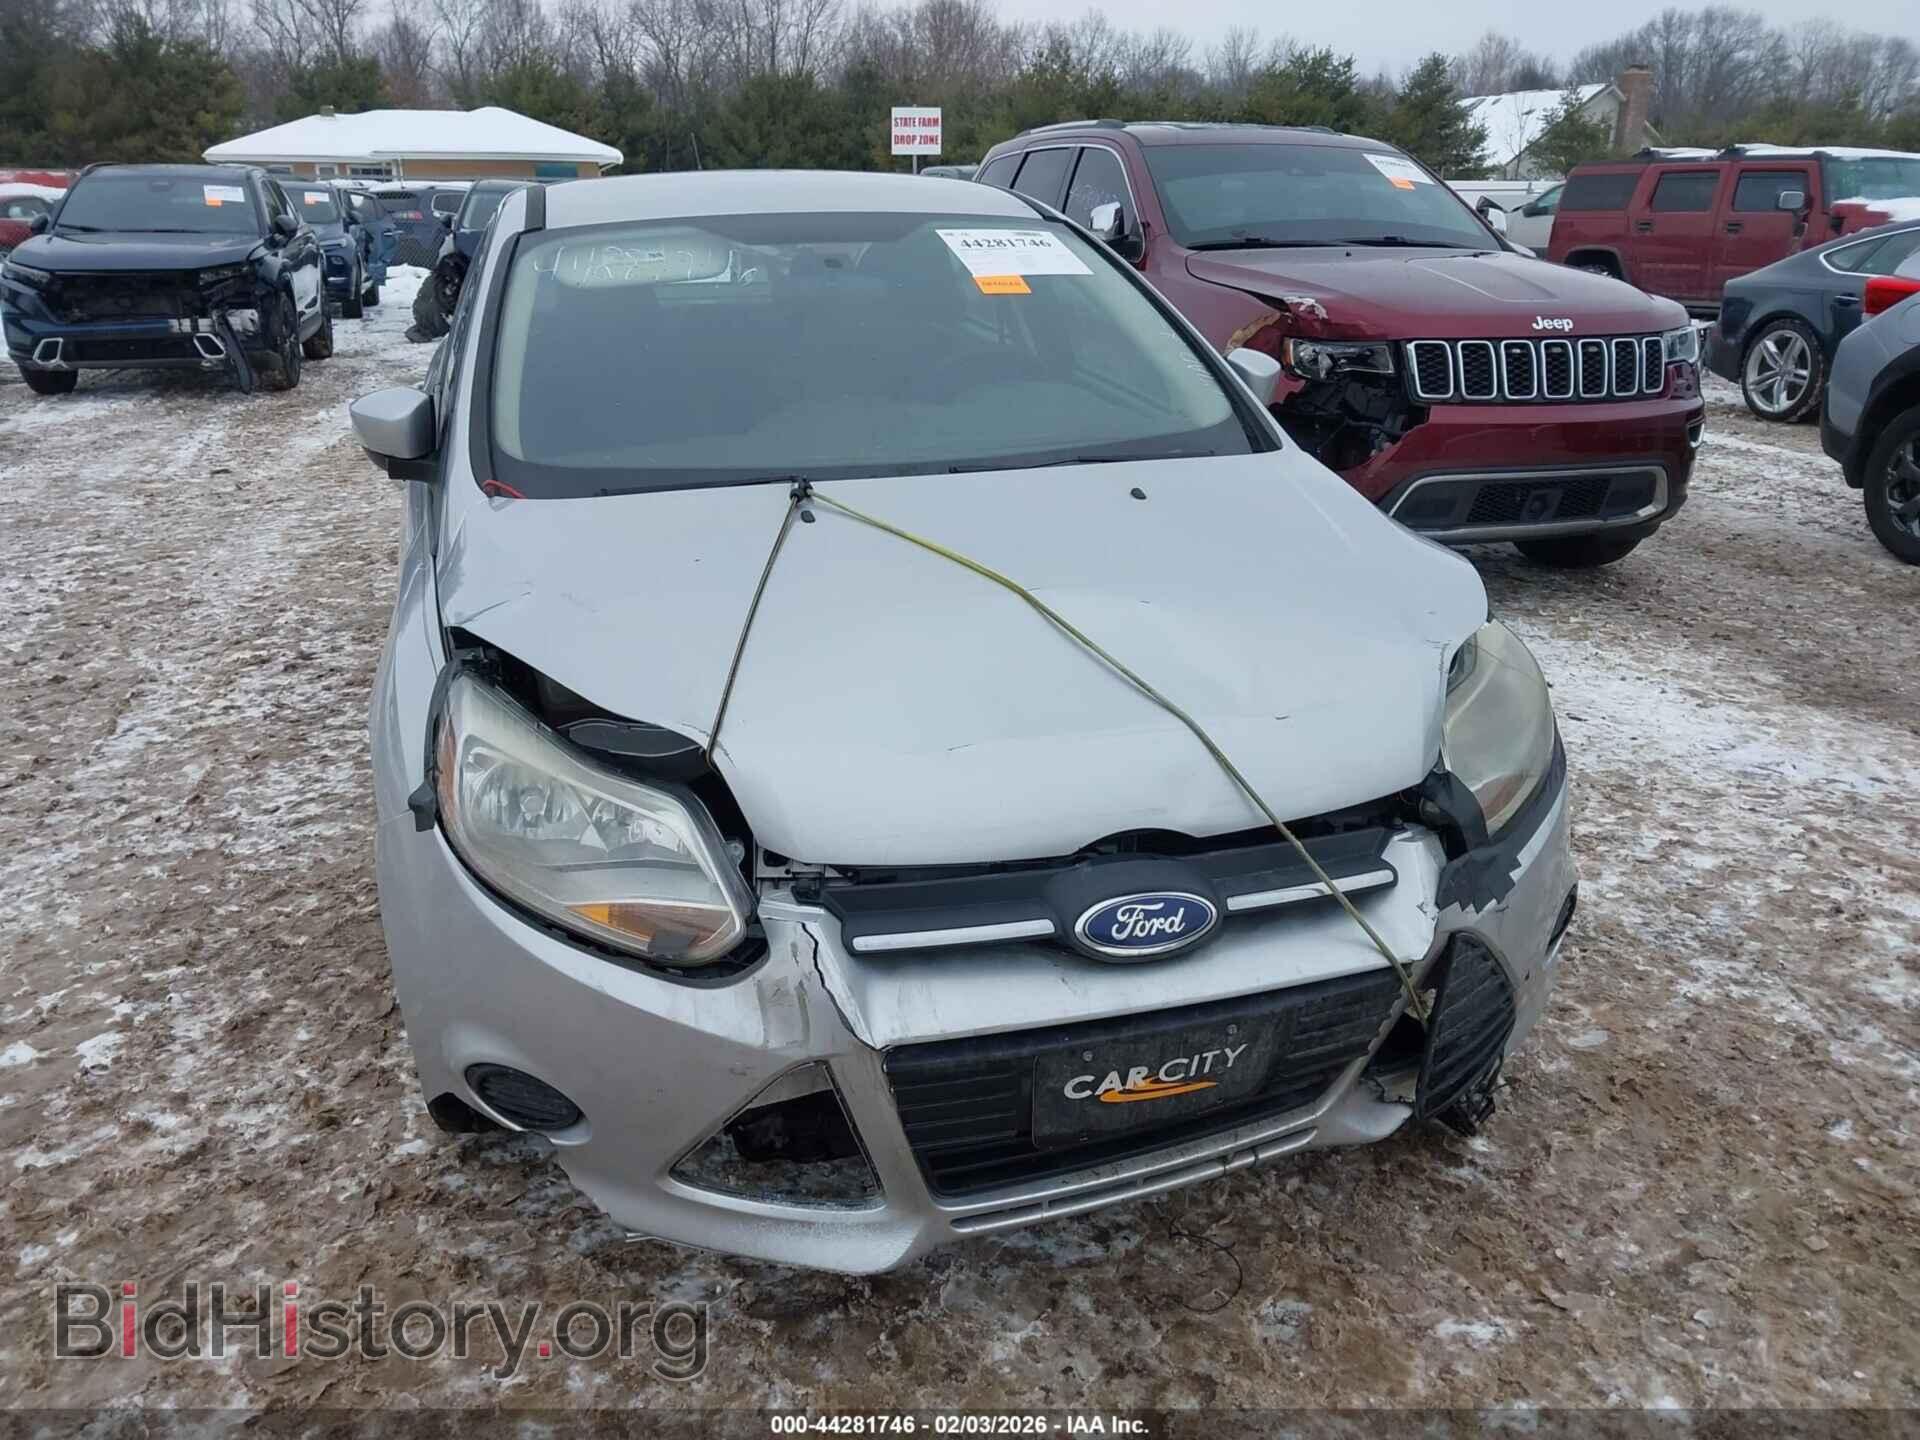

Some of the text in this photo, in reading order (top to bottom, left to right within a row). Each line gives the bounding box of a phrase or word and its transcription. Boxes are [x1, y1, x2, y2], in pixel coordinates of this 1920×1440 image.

[894, 117, 939, 127] STATE FARM
[894, 134, 939, 145] DROP ZONE
[961, 239, 1052, 249] 44281746
[1532, 315, 1574, 332] Jeep
[1111, 901, 1186, 940] Ford
[1063, 1043, 1249, 1100] CAR CITY
